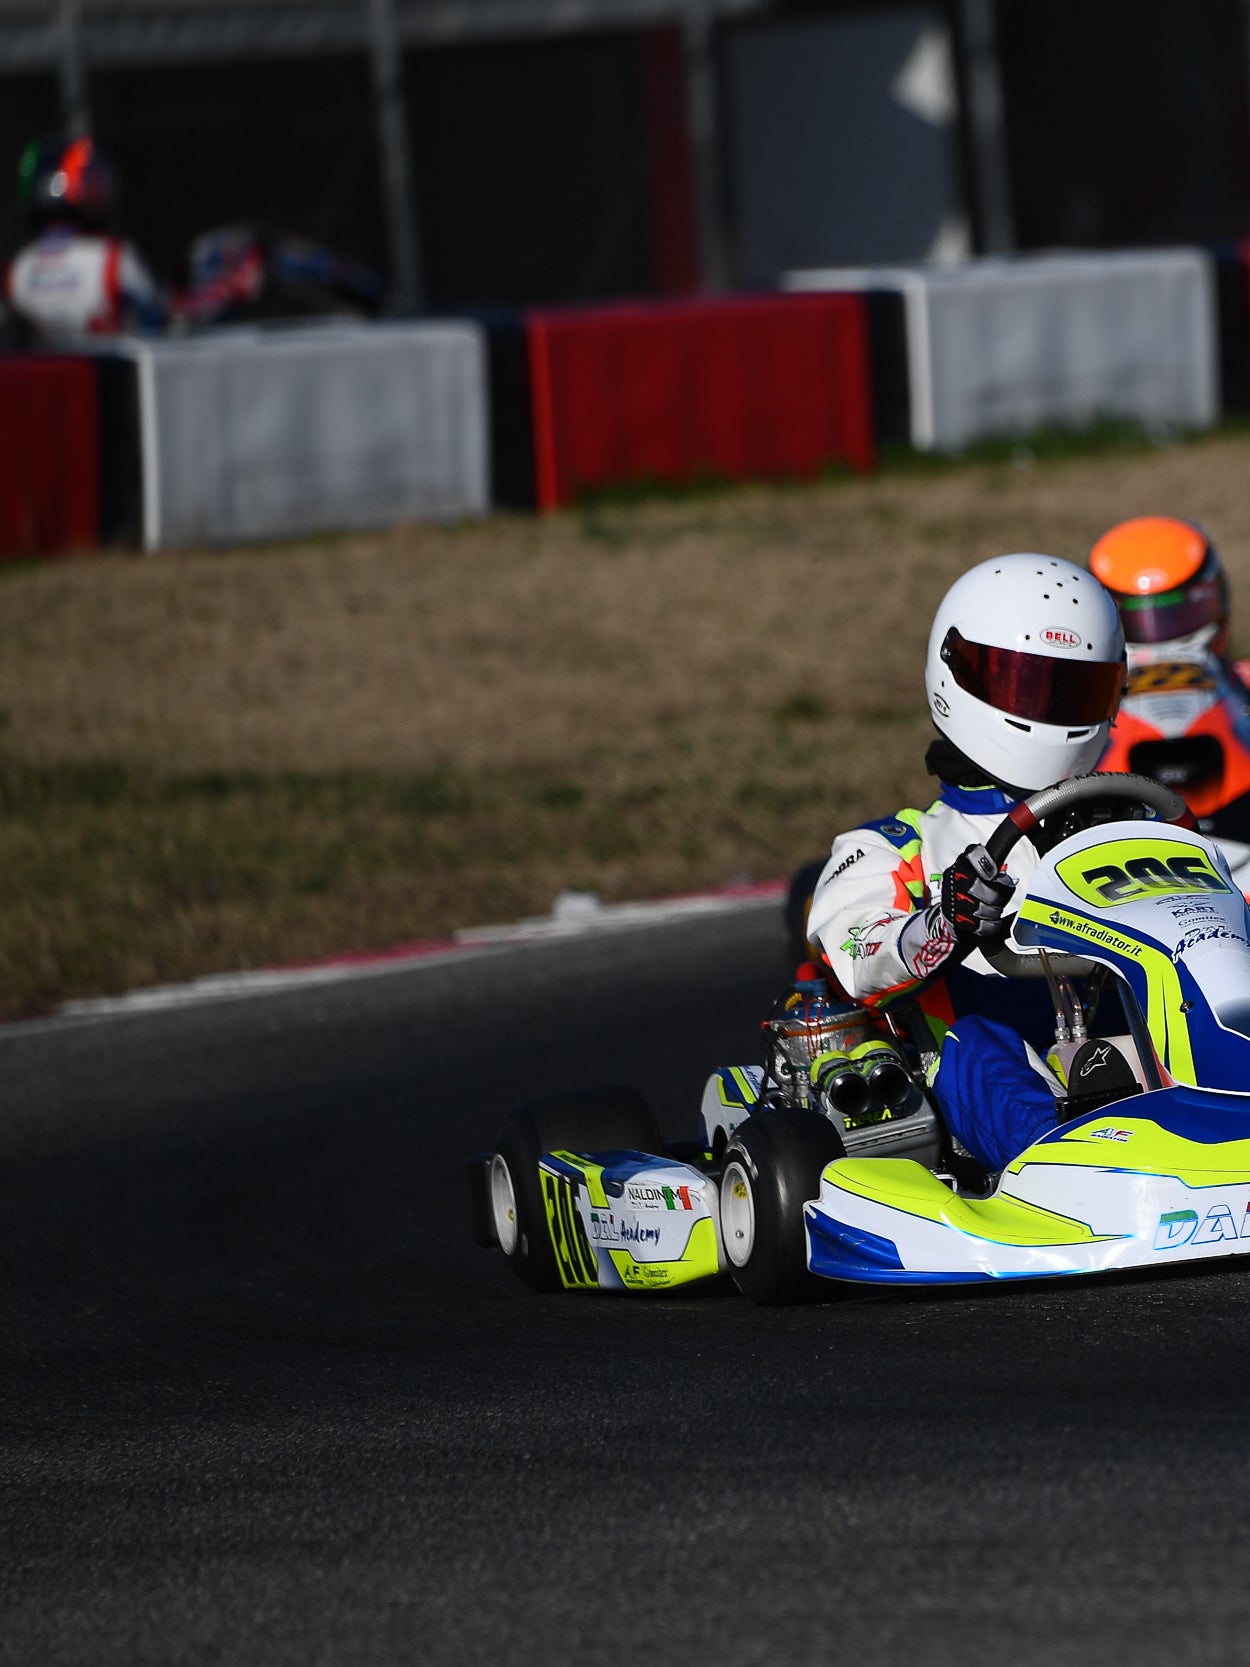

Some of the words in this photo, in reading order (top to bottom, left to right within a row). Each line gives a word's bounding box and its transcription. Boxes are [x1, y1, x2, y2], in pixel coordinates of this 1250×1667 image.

[1045, 631, 1076, 645] BELL
[1080, 857, 1230, 902] 206
[1050, 914, 1142, 957] ww.afradiator.it
[621, 1219, 661, 1246] Academy
